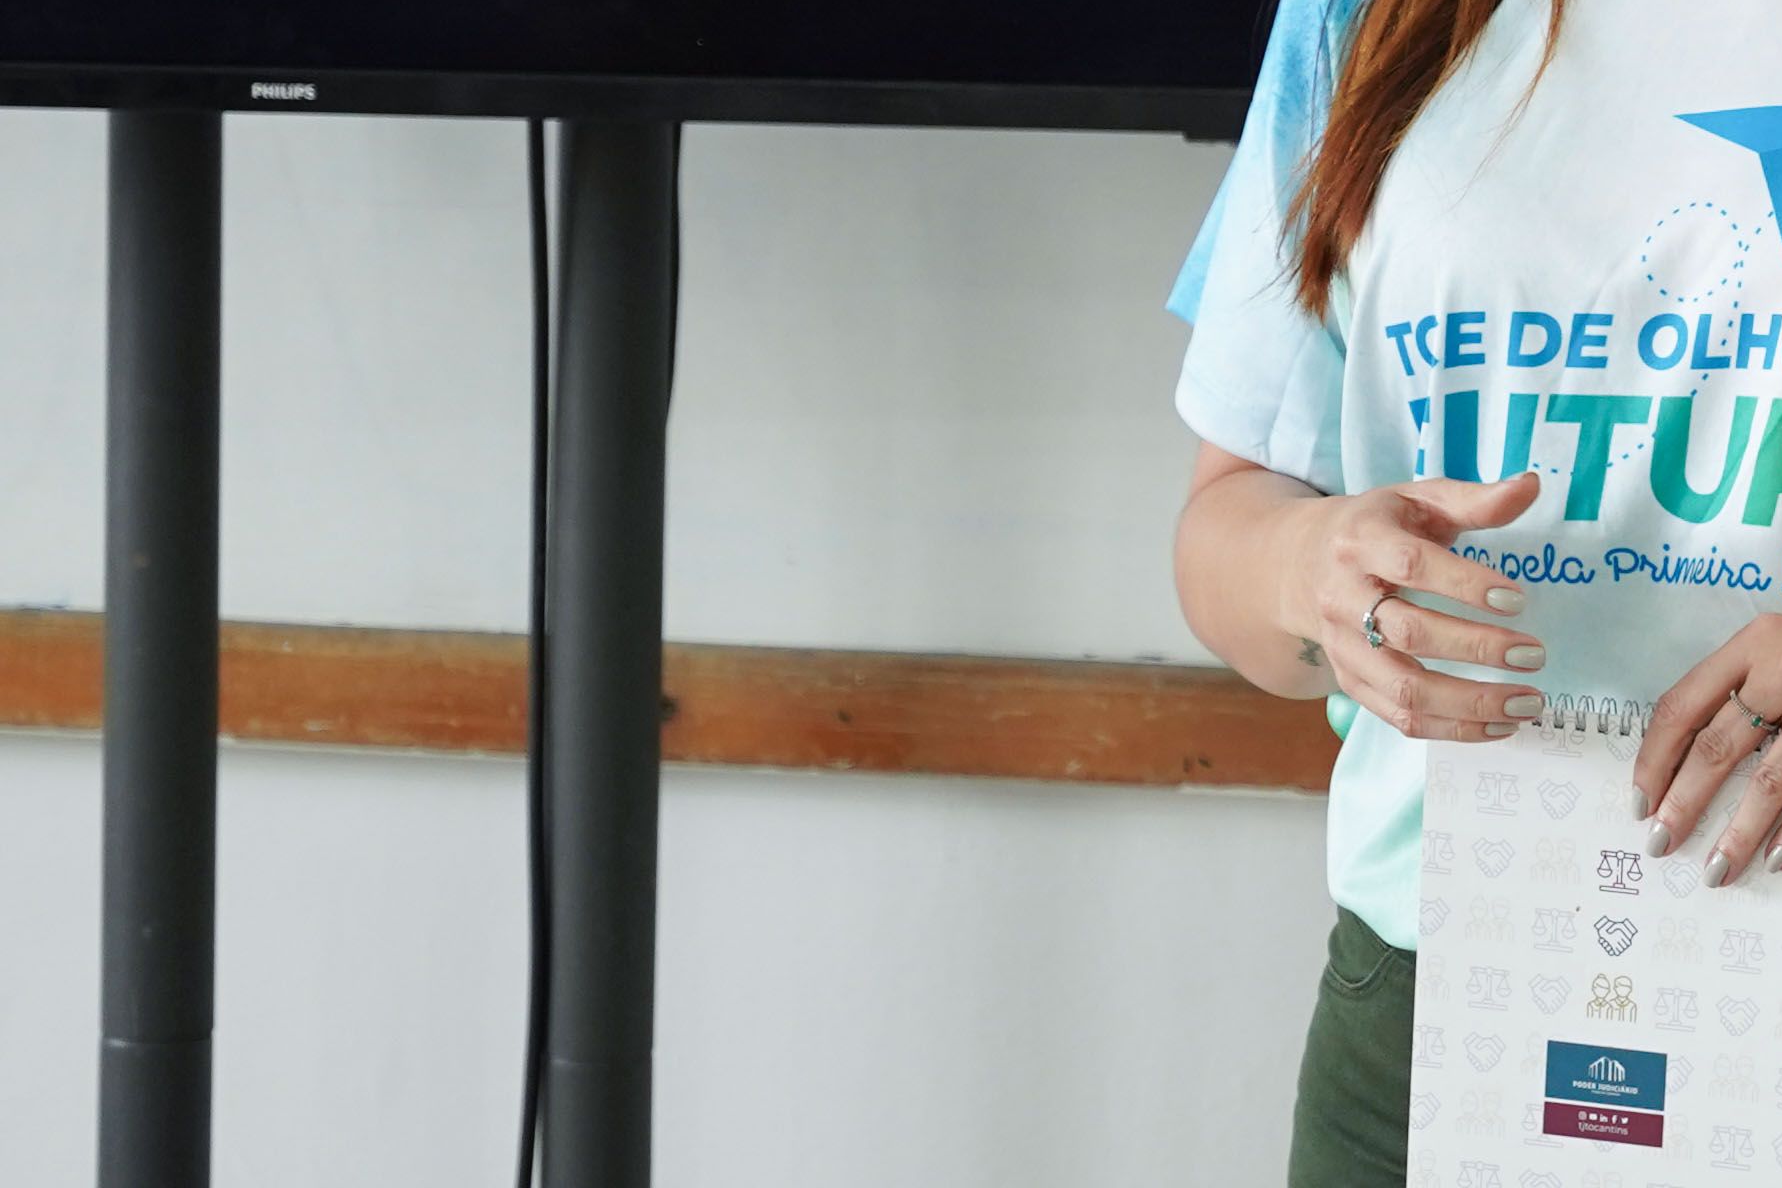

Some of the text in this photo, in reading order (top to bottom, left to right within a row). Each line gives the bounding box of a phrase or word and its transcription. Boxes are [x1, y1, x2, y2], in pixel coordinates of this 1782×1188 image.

[250, 82, 317, 101] PHILIPS
[1385, 311, 1486, 376] TCE
[1507, 311, 1614, 369] DE
[1604, 543, 1772, 591] Primeira
